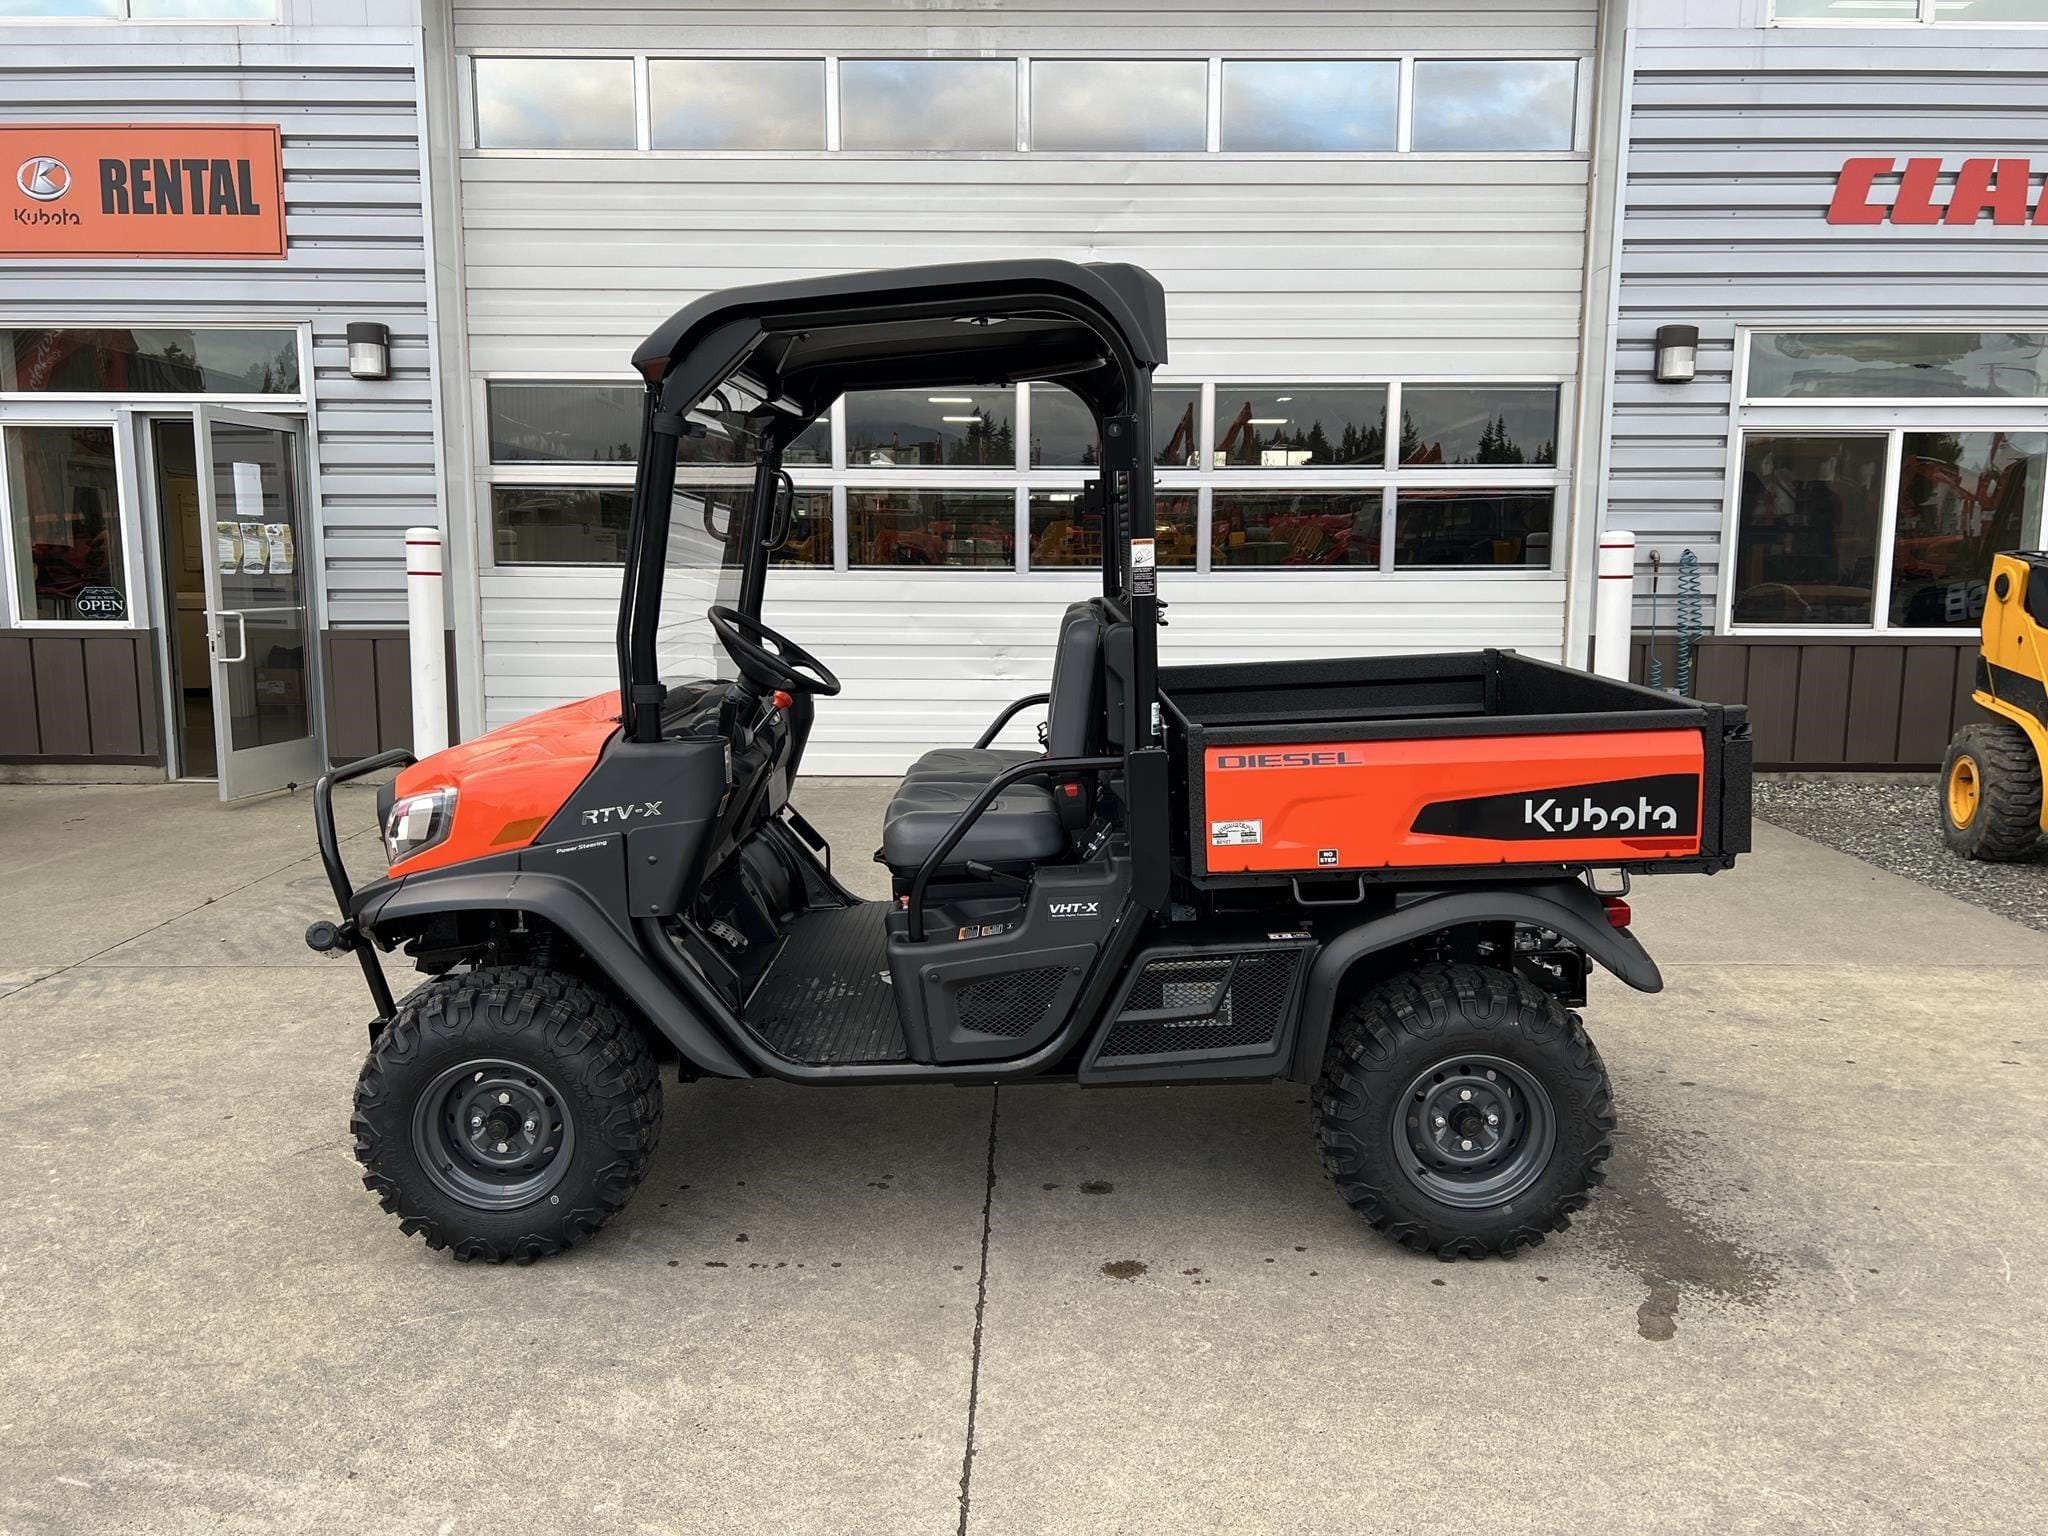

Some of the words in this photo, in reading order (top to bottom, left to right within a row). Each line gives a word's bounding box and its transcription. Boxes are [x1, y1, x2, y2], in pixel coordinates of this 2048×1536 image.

[99, 158, 260, 215] RENTAL
[1826, 157, 2048, 226] CLA
[14, 208, 80, 226] Kubota
[78, 599, 123, 611] OPEN
[1218, 752, 1363, 769] DIESEL
[581, 800, 663, 826] RTV-X
[1525, 796, 1678, 832] Kubota
[578, 840, 608, 850] Steering
[1050, 902, 1099, 914] VHT-X
